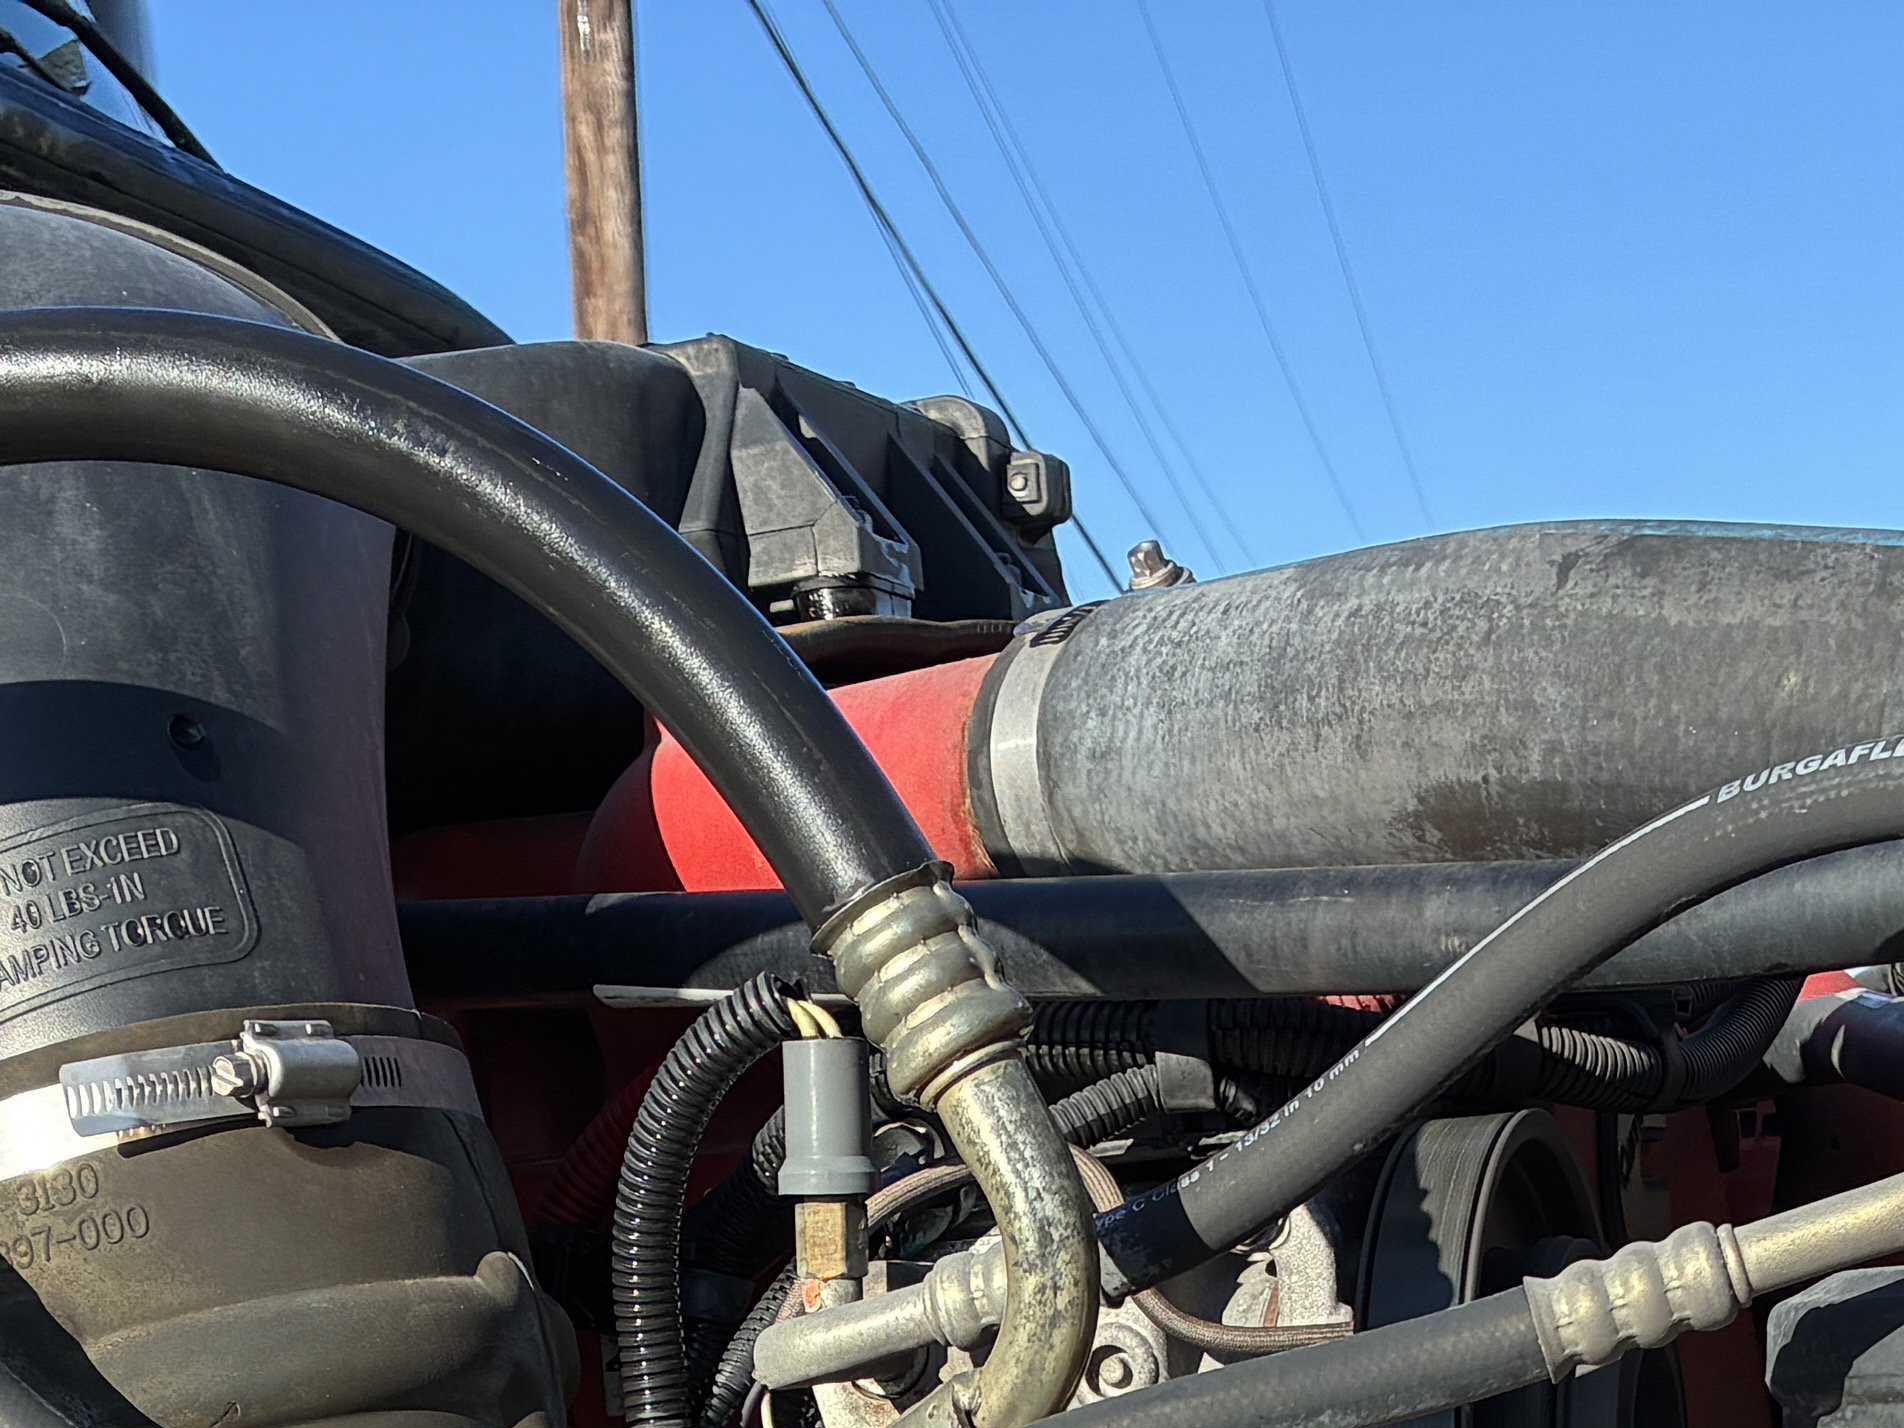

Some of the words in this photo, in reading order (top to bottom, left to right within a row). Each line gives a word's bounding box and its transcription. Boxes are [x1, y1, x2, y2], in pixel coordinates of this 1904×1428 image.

[63, 827, 180, 876] EXCEED
[10, 902, 43, 934] 40
[104, 905, 229, 954] TORQUE
[1096, 1210, 1126, 1231] ype
[1235, 1114, 1281, 1152] 13/32
[1304, 1078, 1325, 1099] 10
[1329, 1049, 1360, 1081] mm
[17, 1162, 100, 1217] 3130
